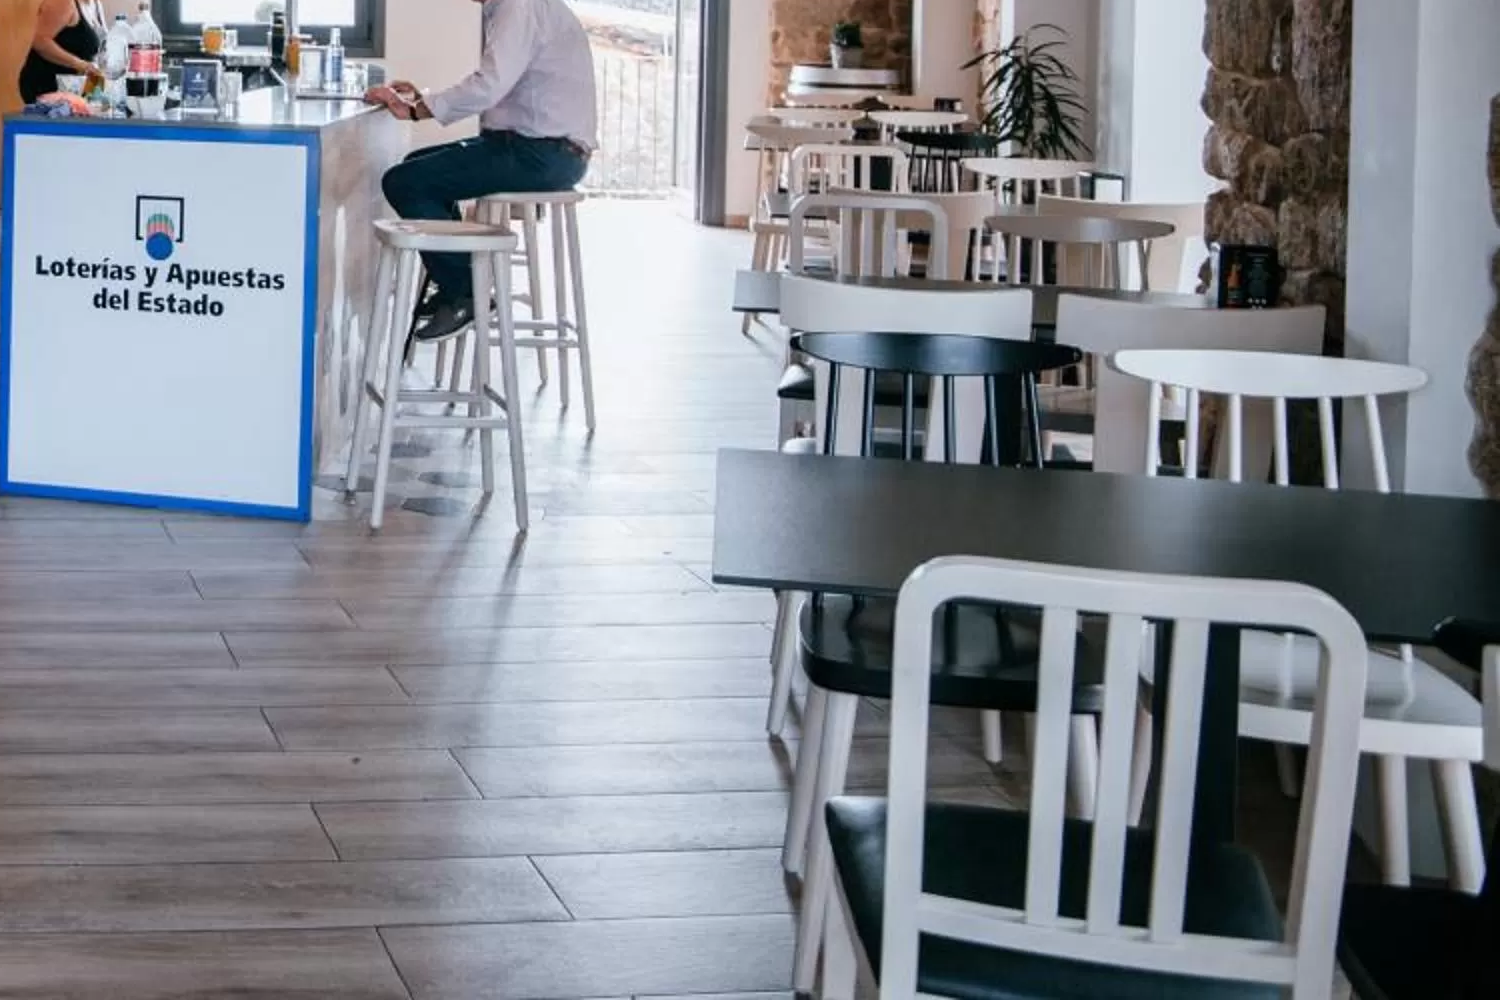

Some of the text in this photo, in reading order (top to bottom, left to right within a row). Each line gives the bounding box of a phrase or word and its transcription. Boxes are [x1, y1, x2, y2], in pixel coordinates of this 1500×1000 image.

[35, 254, 286, 291] Loterías y Apuestas
[93, 288, 224, 317] del Estado
